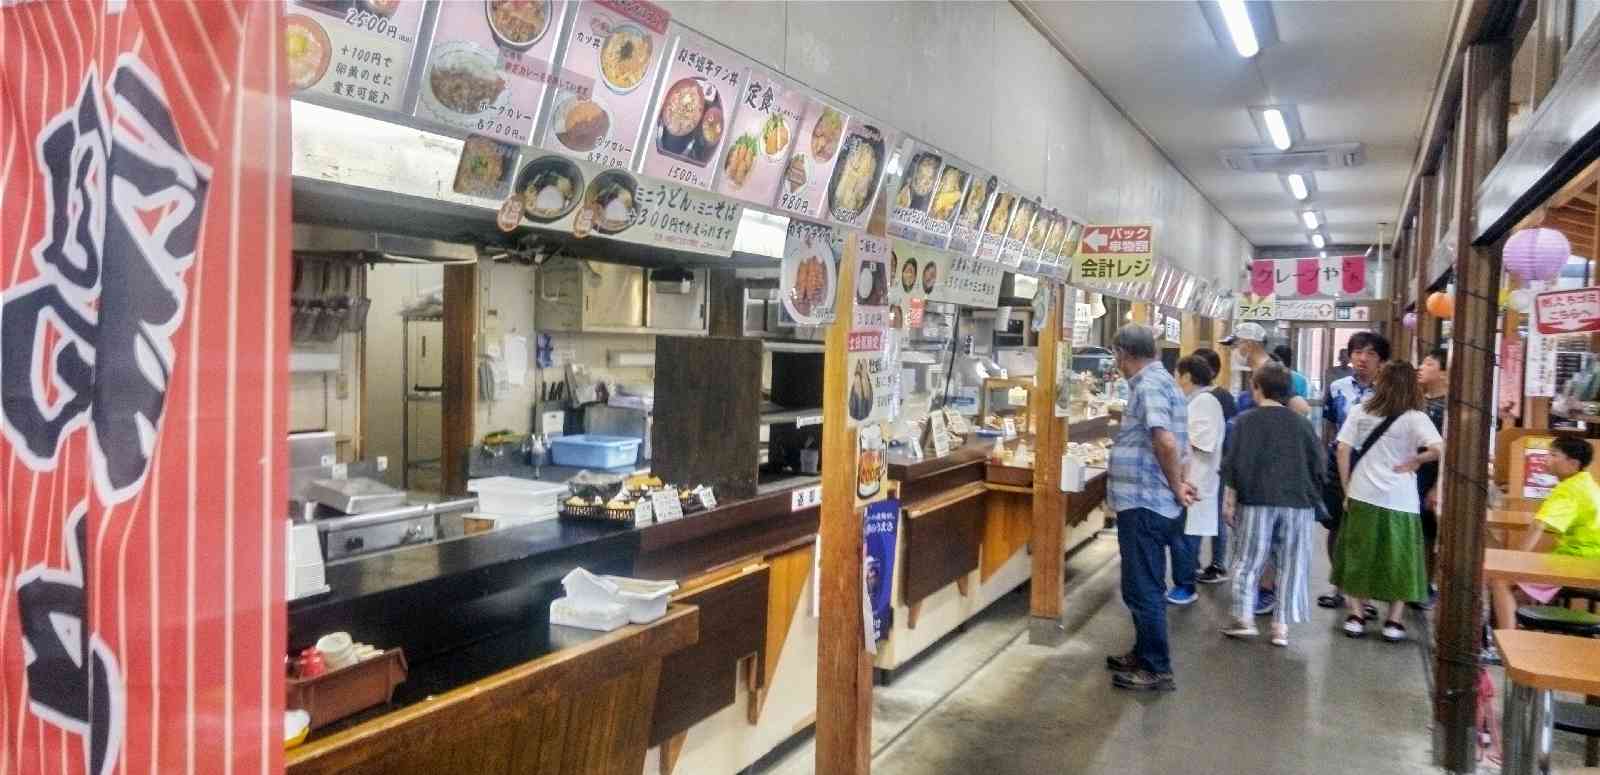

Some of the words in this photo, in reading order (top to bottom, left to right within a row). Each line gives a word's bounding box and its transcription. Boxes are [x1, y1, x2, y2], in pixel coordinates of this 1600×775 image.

[345, 8, 398, 39] 2500円
[576, 31, 601, 49] カツ丼
[678, 47, 739, 87] ねぎ塩牛タン丼
[745, 81, 775, 114] 定食
[667, 165, 698, 185] 1500円
[781, 193, 809, 214] 980円
[1081, 258, 1151, 278] 会計レジ
[1239, 305, 1272, 318] アイス
